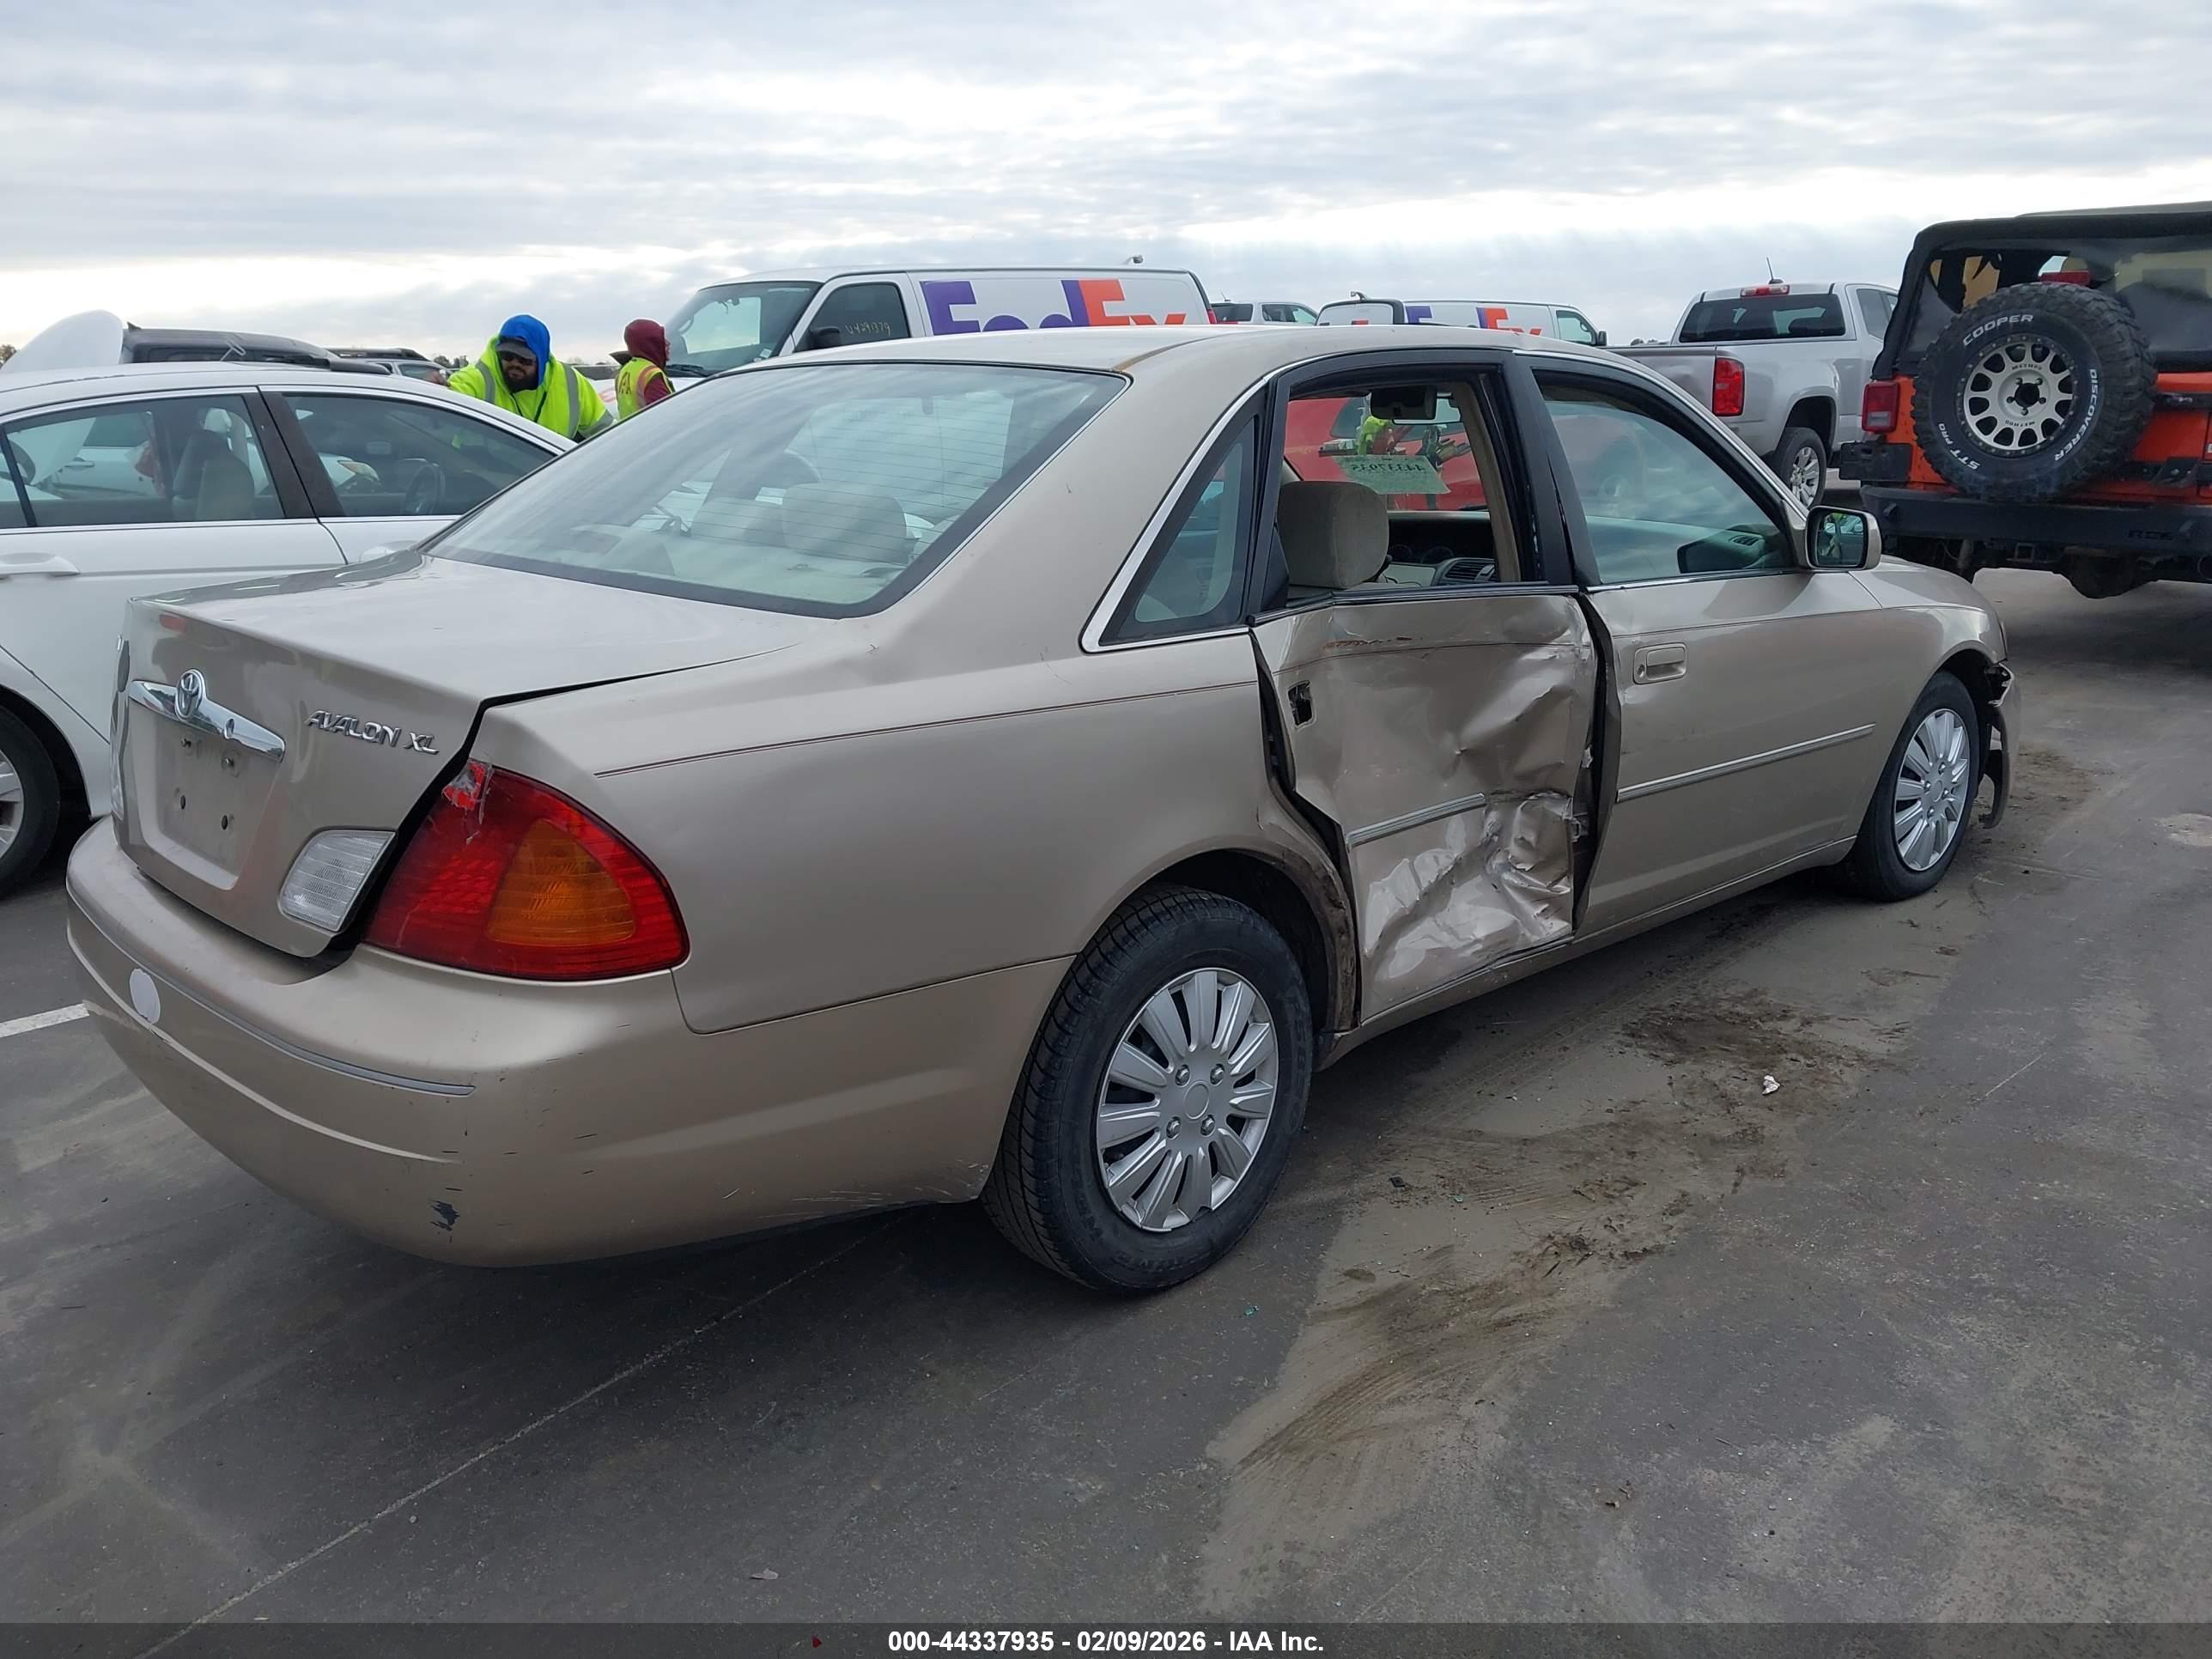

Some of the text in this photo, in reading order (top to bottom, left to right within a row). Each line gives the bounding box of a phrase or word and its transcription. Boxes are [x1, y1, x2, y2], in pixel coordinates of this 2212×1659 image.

[1963, 314, 2034, 347] COOPER
[2054, 368, 2099, 461] DISCOVERER
[1938, 423, 1981, 470] STT PRO
[304, 709, 440, 756] AVALON XL
